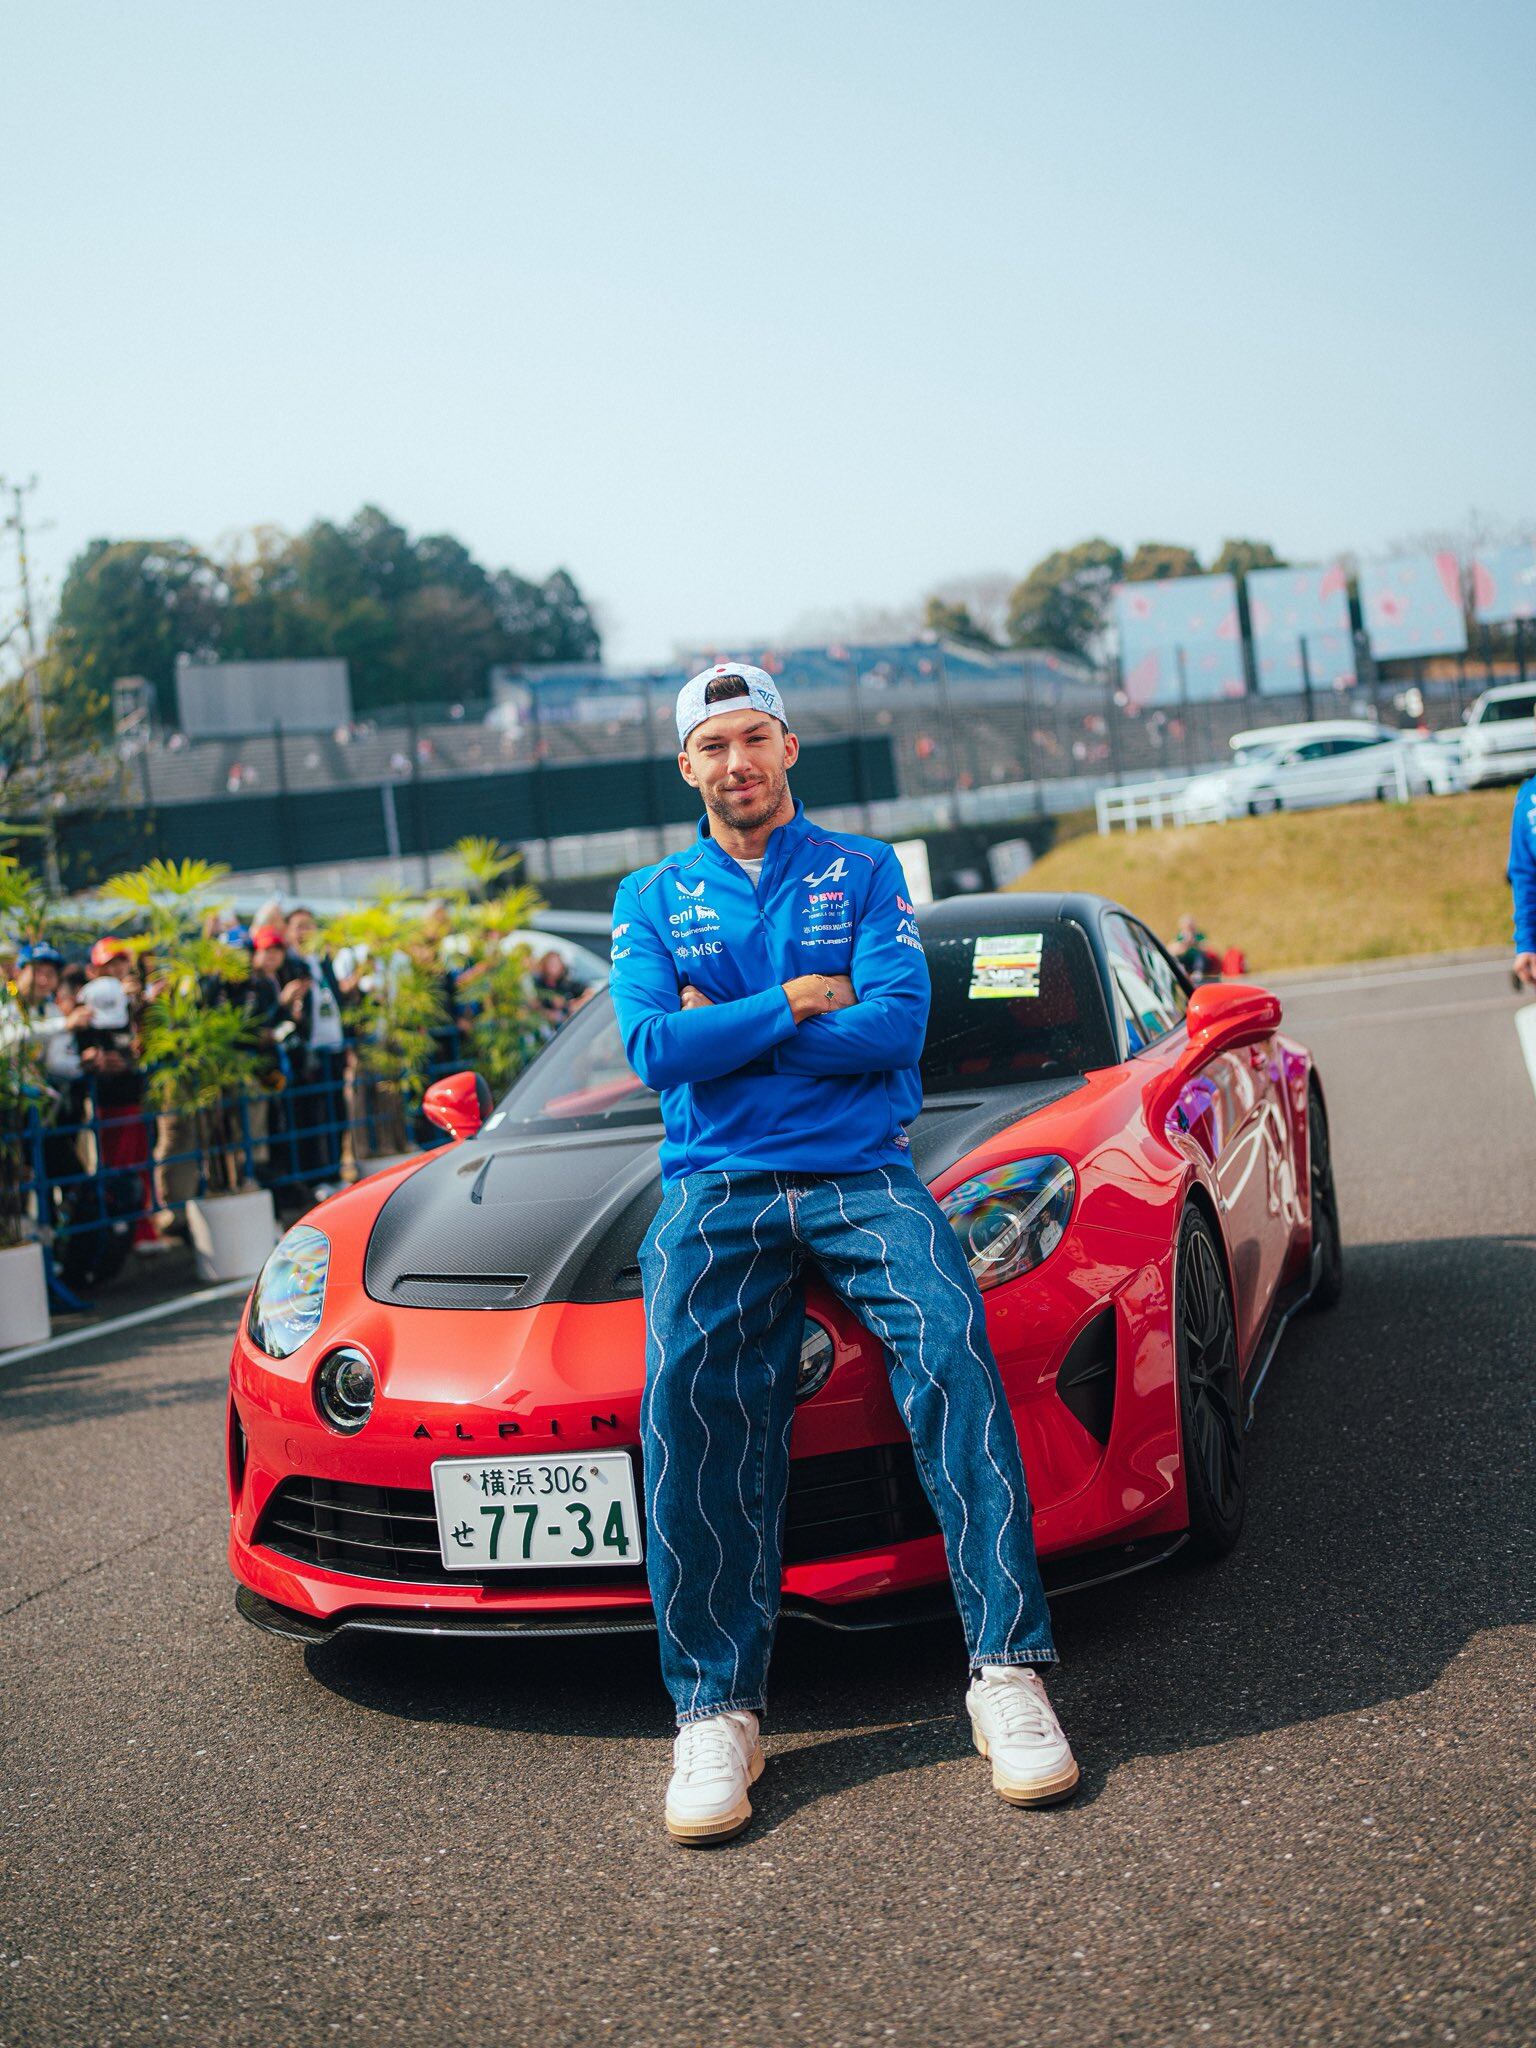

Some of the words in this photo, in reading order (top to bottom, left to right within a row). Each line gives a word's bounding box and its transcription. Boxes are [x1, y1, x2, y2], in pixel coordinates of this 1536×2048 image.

[668, 905, 693, 925] eni
[801, 899, 850, 914] ALPINE
[690, 941, 723, 958] MSC
[413, 1413, 618, 1440] ALPIN
[450, 1520, 475, 1548] せ
[480, 1500, 630, 1560] 77-34
